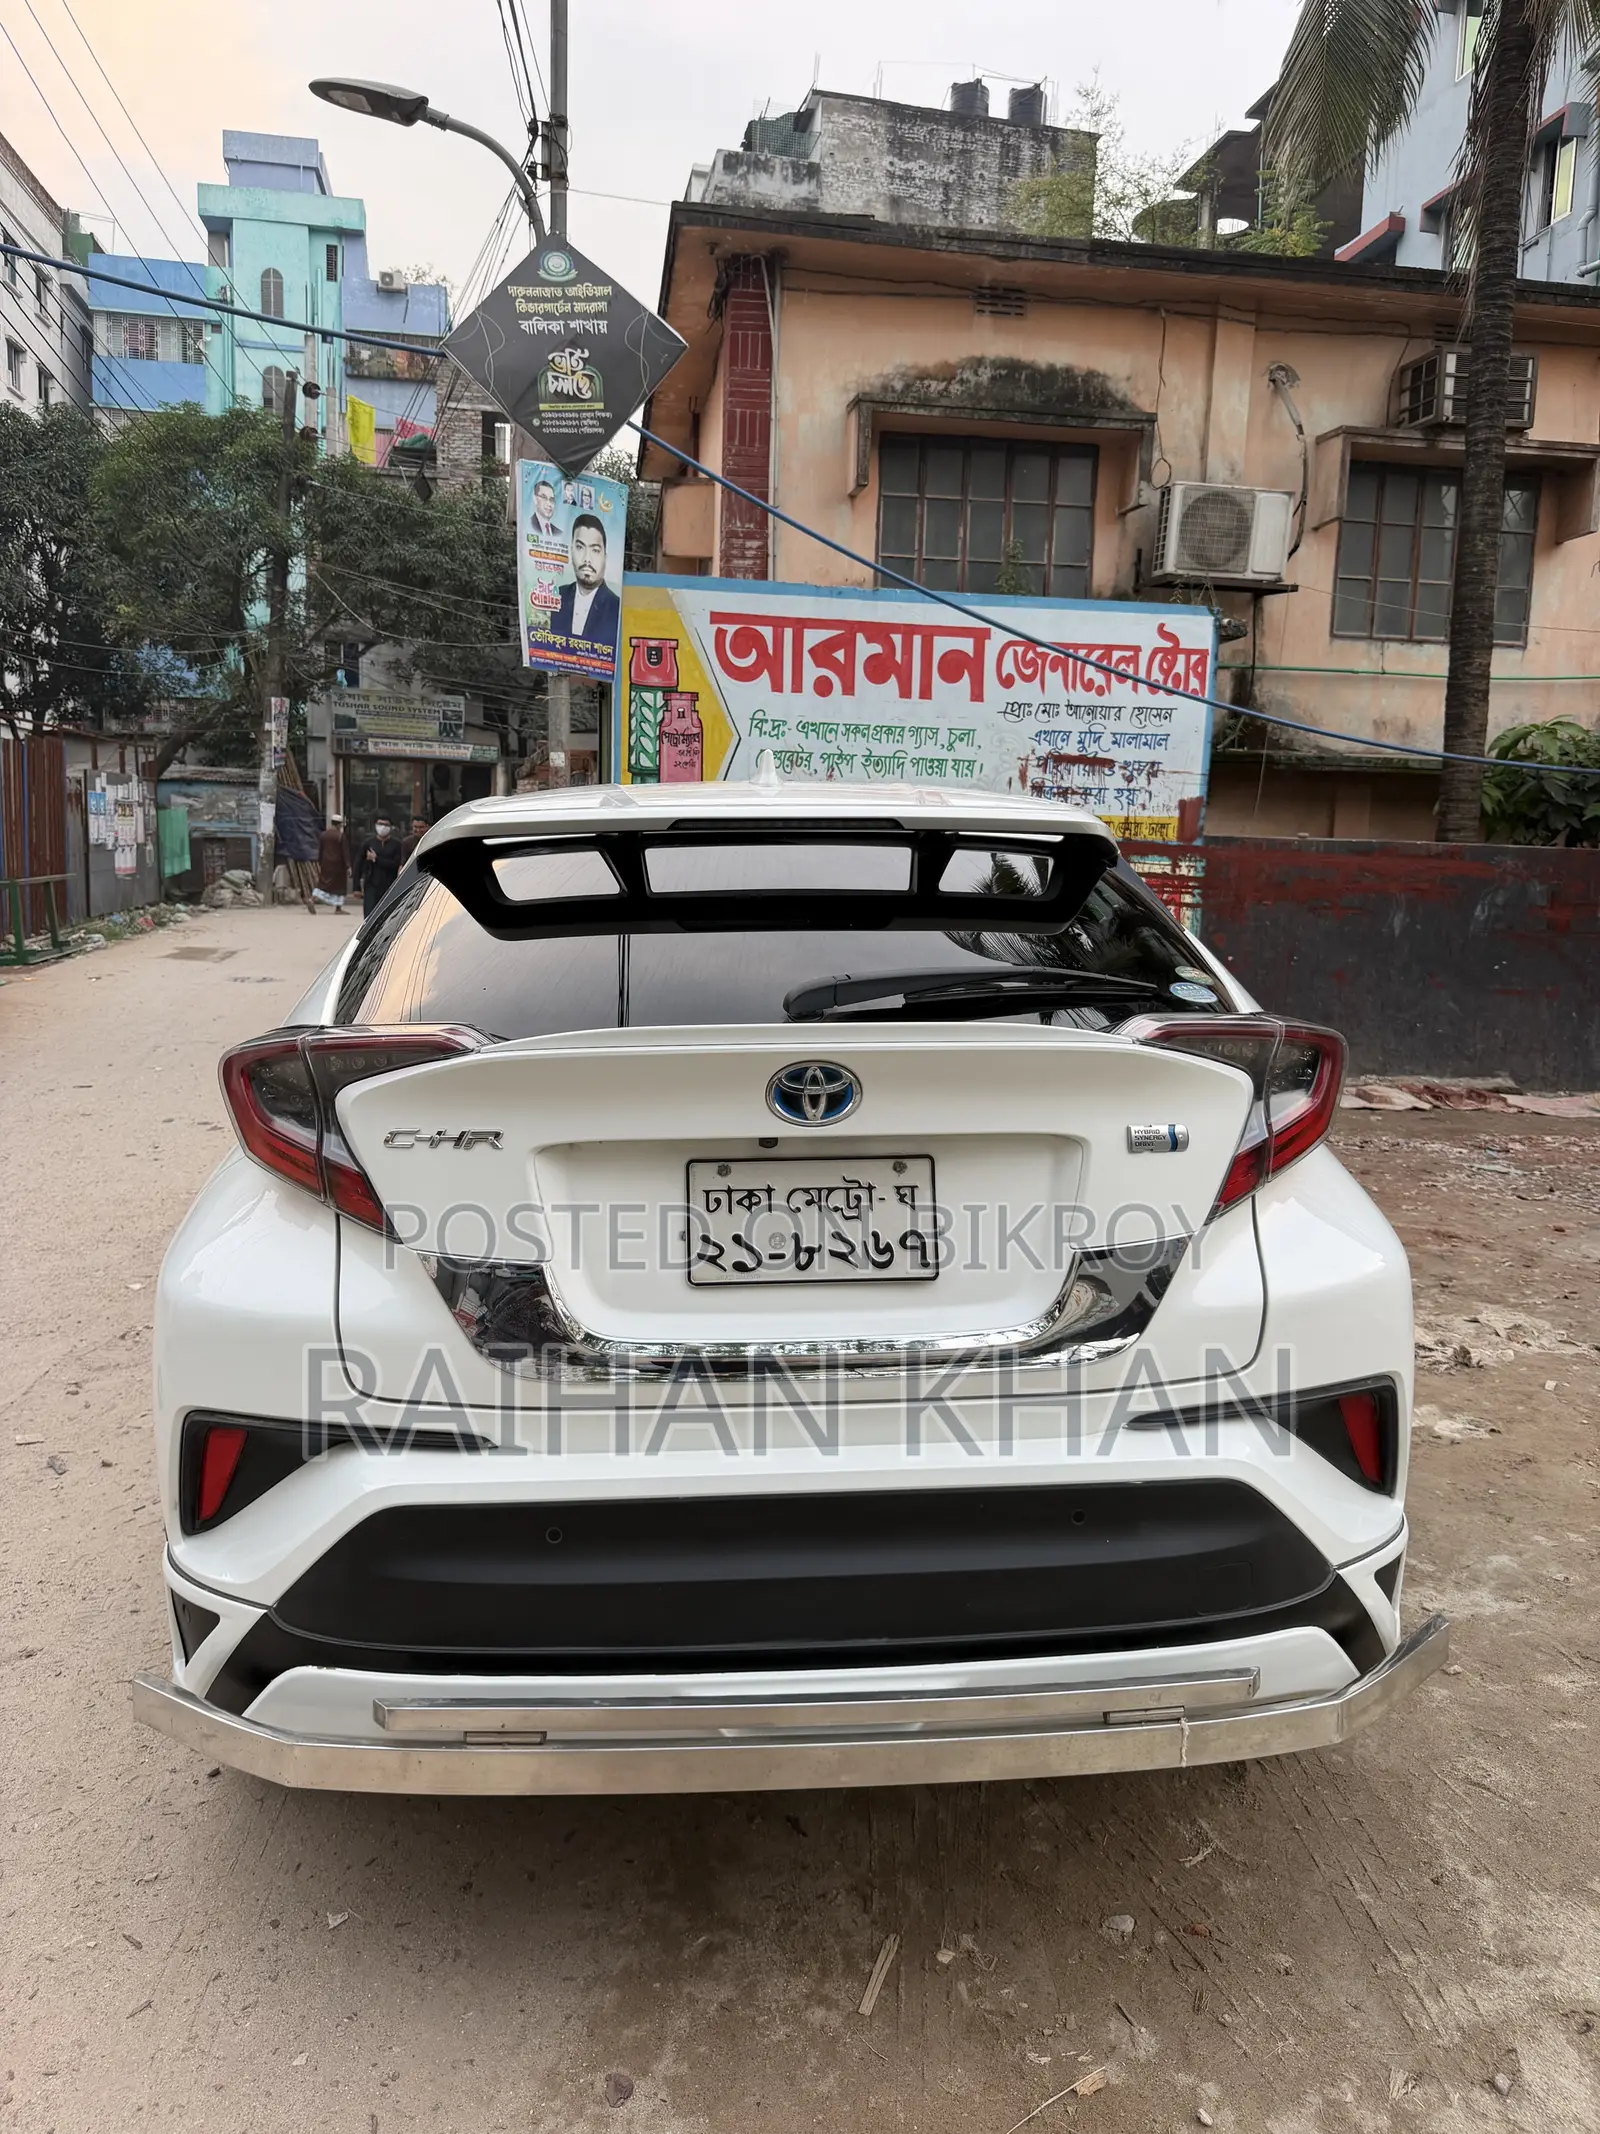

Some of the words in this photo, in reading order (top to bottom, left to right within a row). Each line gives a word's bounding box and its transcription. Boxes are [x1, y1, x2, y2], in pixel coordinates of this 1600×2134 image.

[565, 282, 612, 299] আইডিয়াল
[573, 300, 608, 314] মাদরাসা
[518, 316, 565, 336] বালিকা
[567, 318, 608, 335] শাখায়
[709, 611, 991, 702] আরমান
[996, 639, 1143, 697] জেনারেল
[333, 700, 371, 711] TUSHAR
[372, 704, 406, 713] SOUND
[407, 707, 441, 716] SYSTEM
[1064, 699, 1127, 725] আনোয়ার
[1129, 705, 1178, 729] হোসেন
[796, 719, 841, 744] এখানে
[842, 722, 872, 743] সকল
[871, 724, 906, 745] প্রকার
[1028, 729, 1073, 751] এখানে
[1077, 722, 1111, 753] মুদি
[1110, 731, 1171, 752] মালামাল
[818, 744, 858, 778] পাইপ
[861, 746, 908, 780] ইত্যাদি
[909, 756, 949, 778] পাওয়া
[383, 1127, 504, 1150] C-HR
[702, 1184, 777, 1215] ঢাকা
[893, 1183, 919, 1211] ঘ
[697, 1229, 931, 1272] ২১-৮২৬৭
